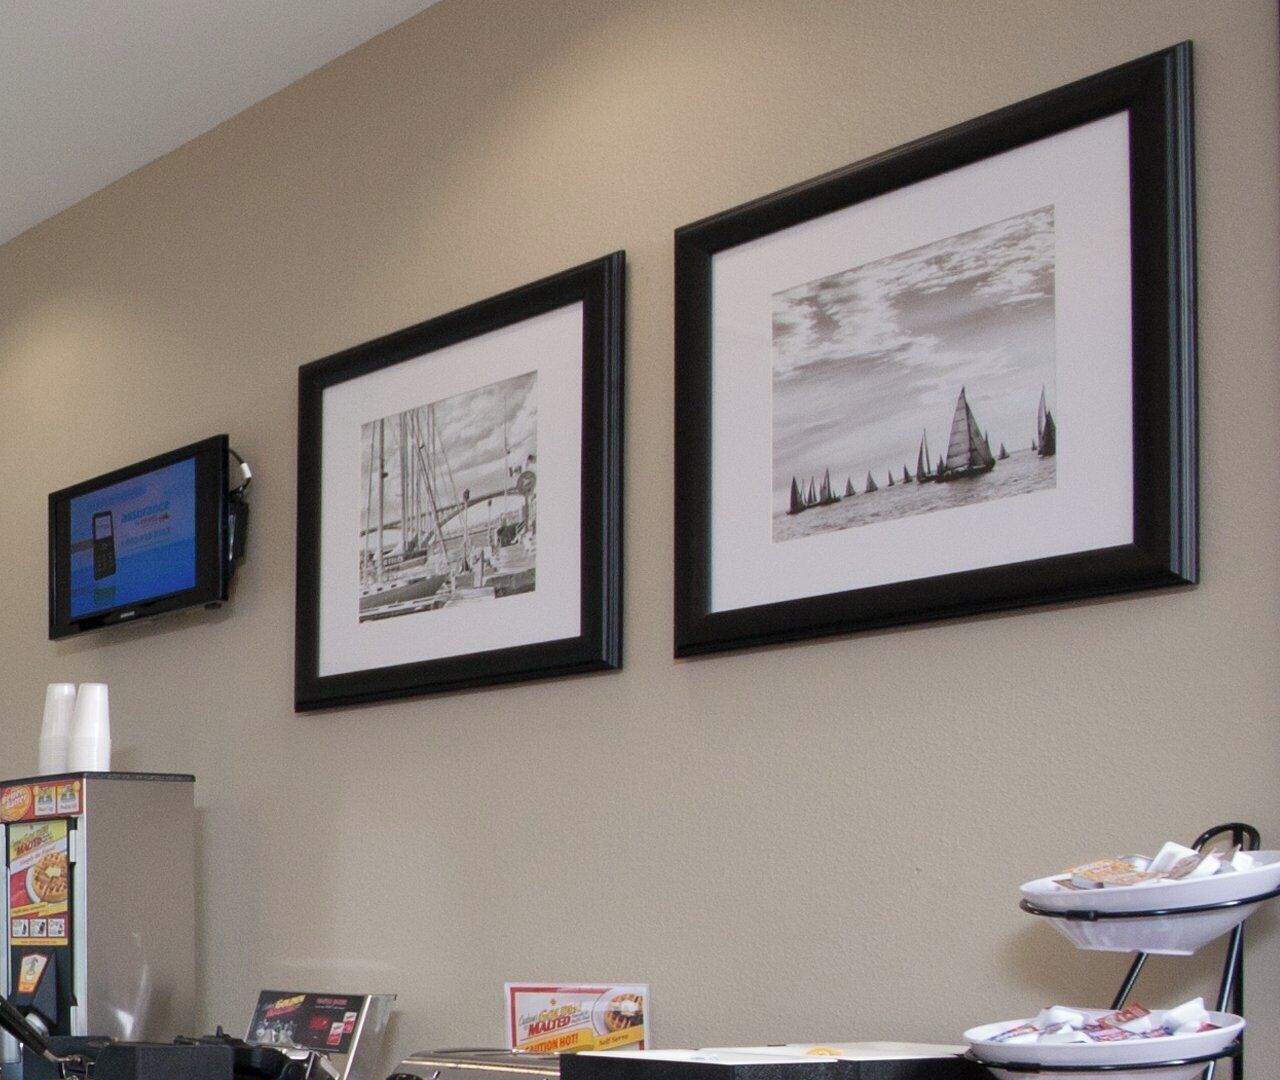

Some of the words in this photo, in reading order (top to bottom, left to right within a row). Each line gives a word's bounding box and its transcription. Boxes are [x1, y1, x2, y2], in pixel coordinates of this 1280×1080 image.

[528, 1015, 571, 1036] MALTED
[525, 1038, 559, 1053] AUTION
[560, 1033, 579, 1048] HOT!
